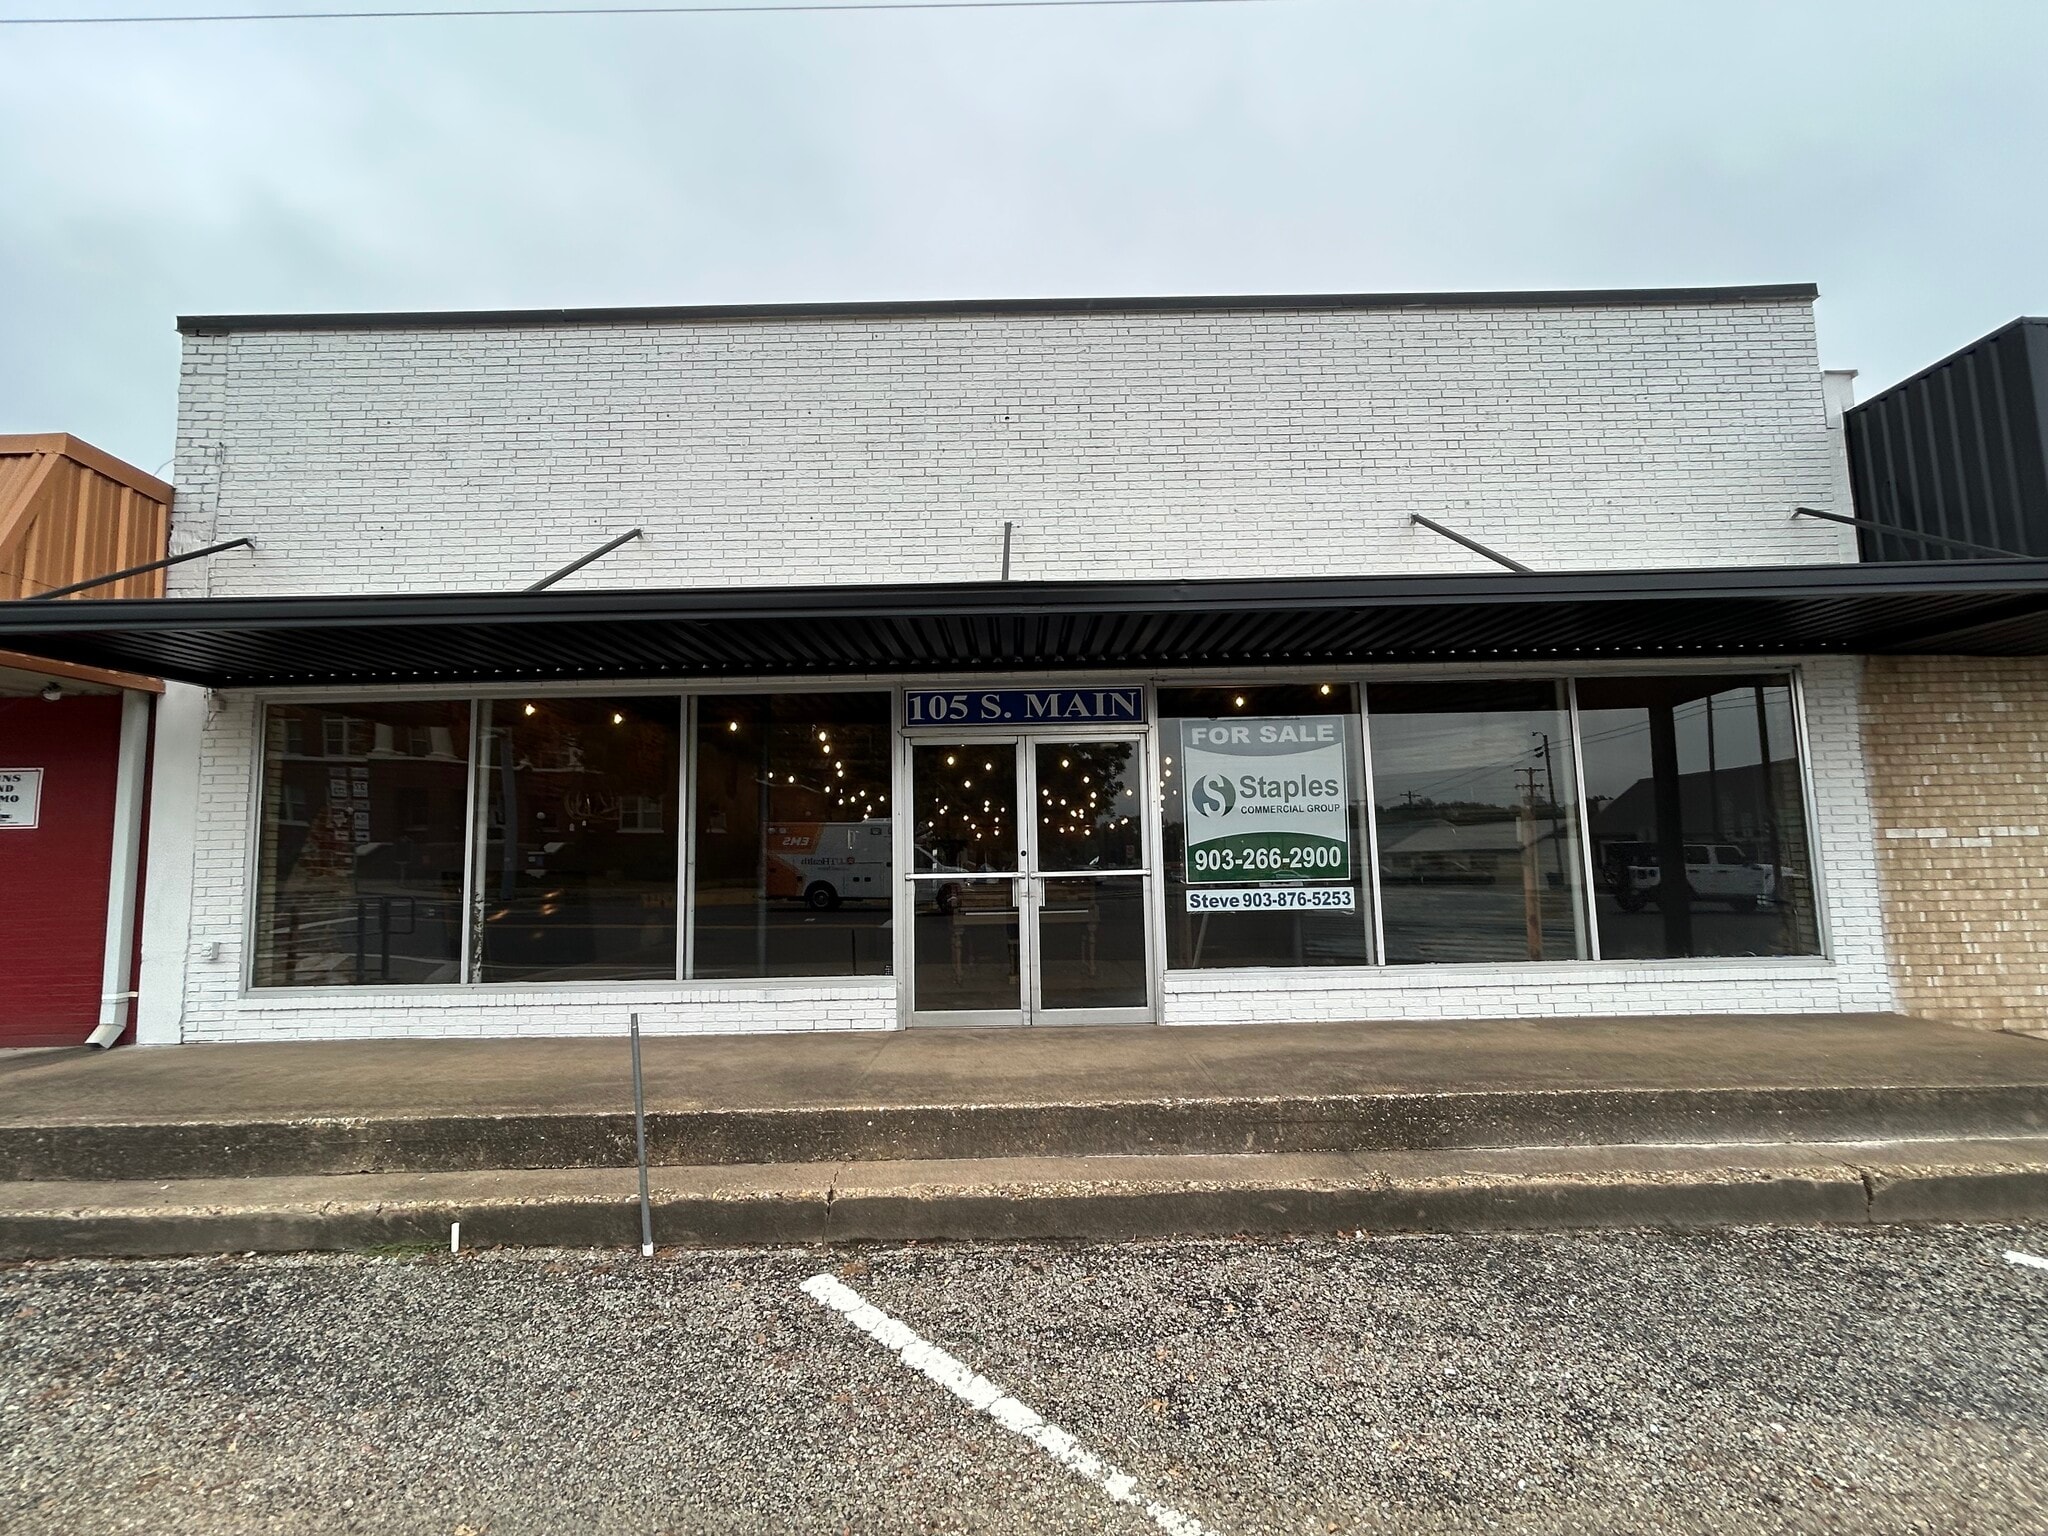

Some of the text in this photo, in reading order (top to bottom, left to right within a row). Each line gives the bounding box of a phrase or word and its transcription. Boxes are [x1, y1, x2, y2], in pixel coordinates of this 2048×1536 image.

[910, 692, 1137, 720] 105 S. MAIN
[1191, 724, 1334, 745] FOR SALE
[1239, 774, 1339, 803] Staples
[1240, 804, 1340, 814] COMMERCIAL GROUP
[1195, 846, 1341, 871] 903-266-2900
[1189, 891, 1351, 909] Steve 903-876-5253
